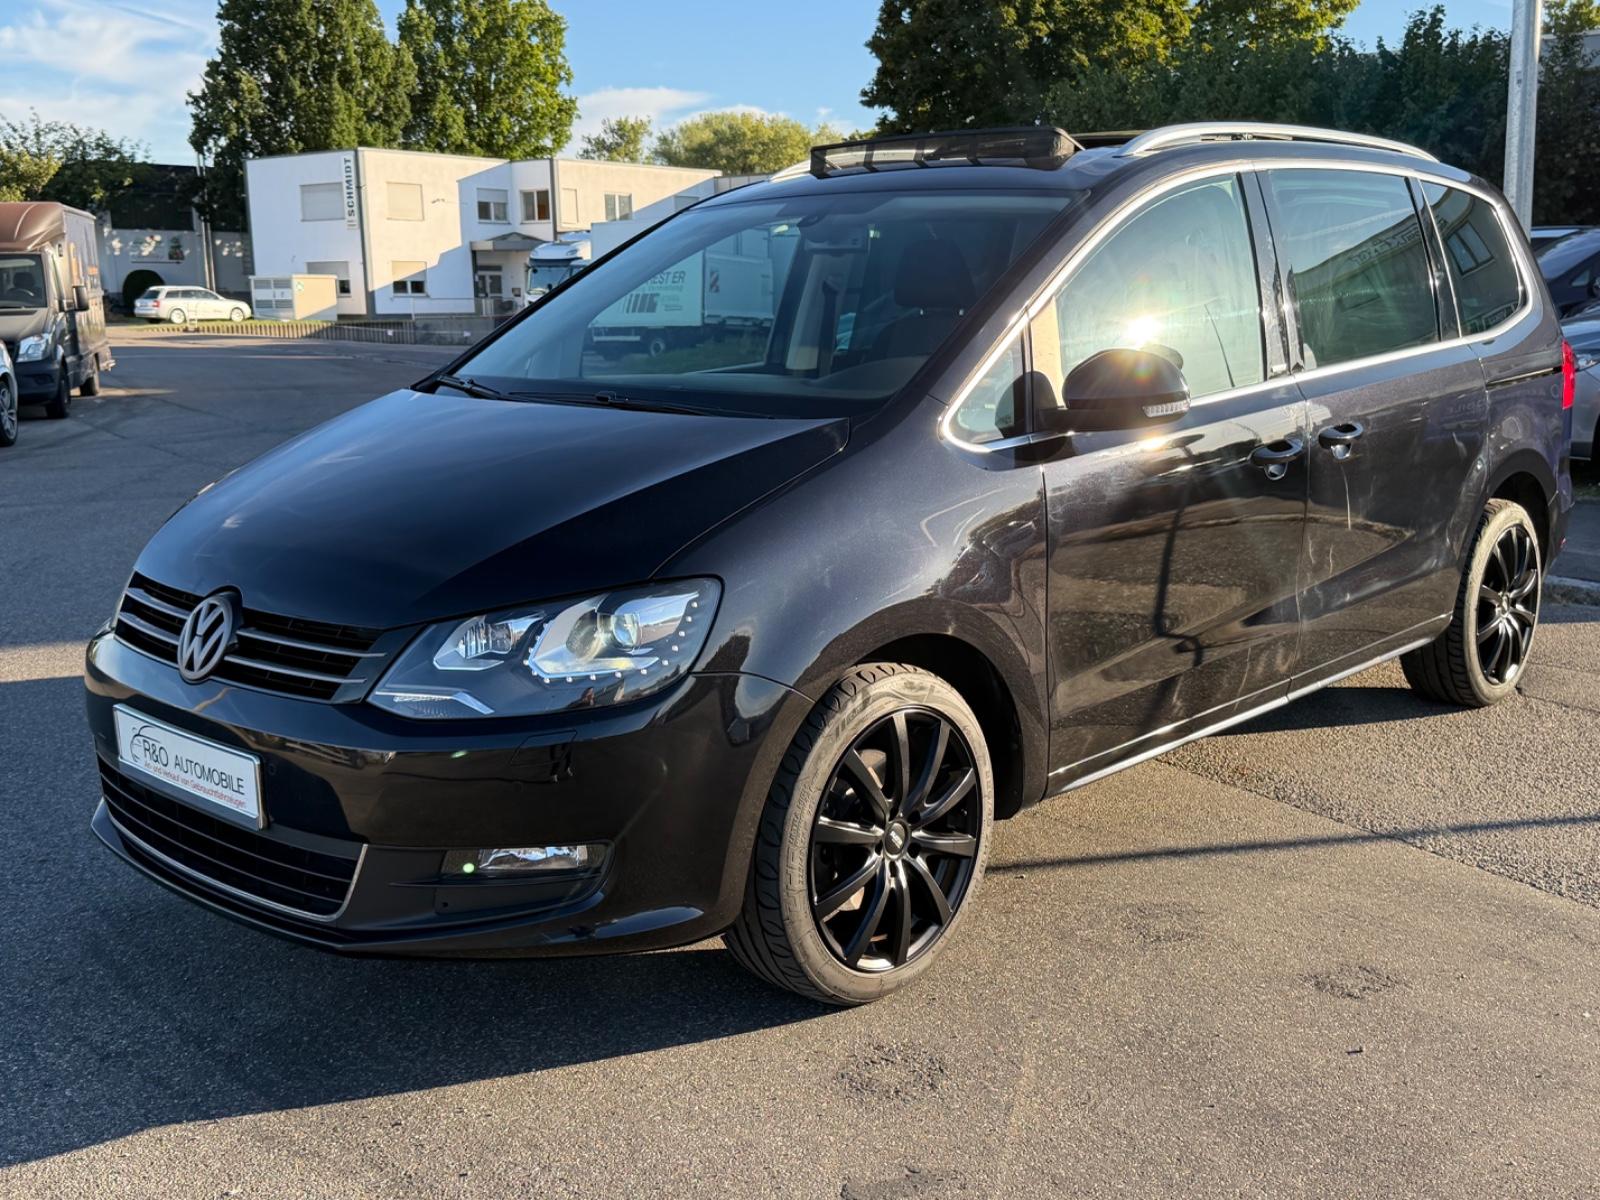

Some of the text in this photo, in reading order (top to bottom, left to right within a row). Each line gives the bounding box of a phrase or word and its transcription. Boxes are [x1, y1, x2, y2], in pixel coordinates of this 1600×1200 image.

[343, 157, 355, 217] SCHMIDT
[142, 739, 246, 796] R&O AUTOMOBILE
